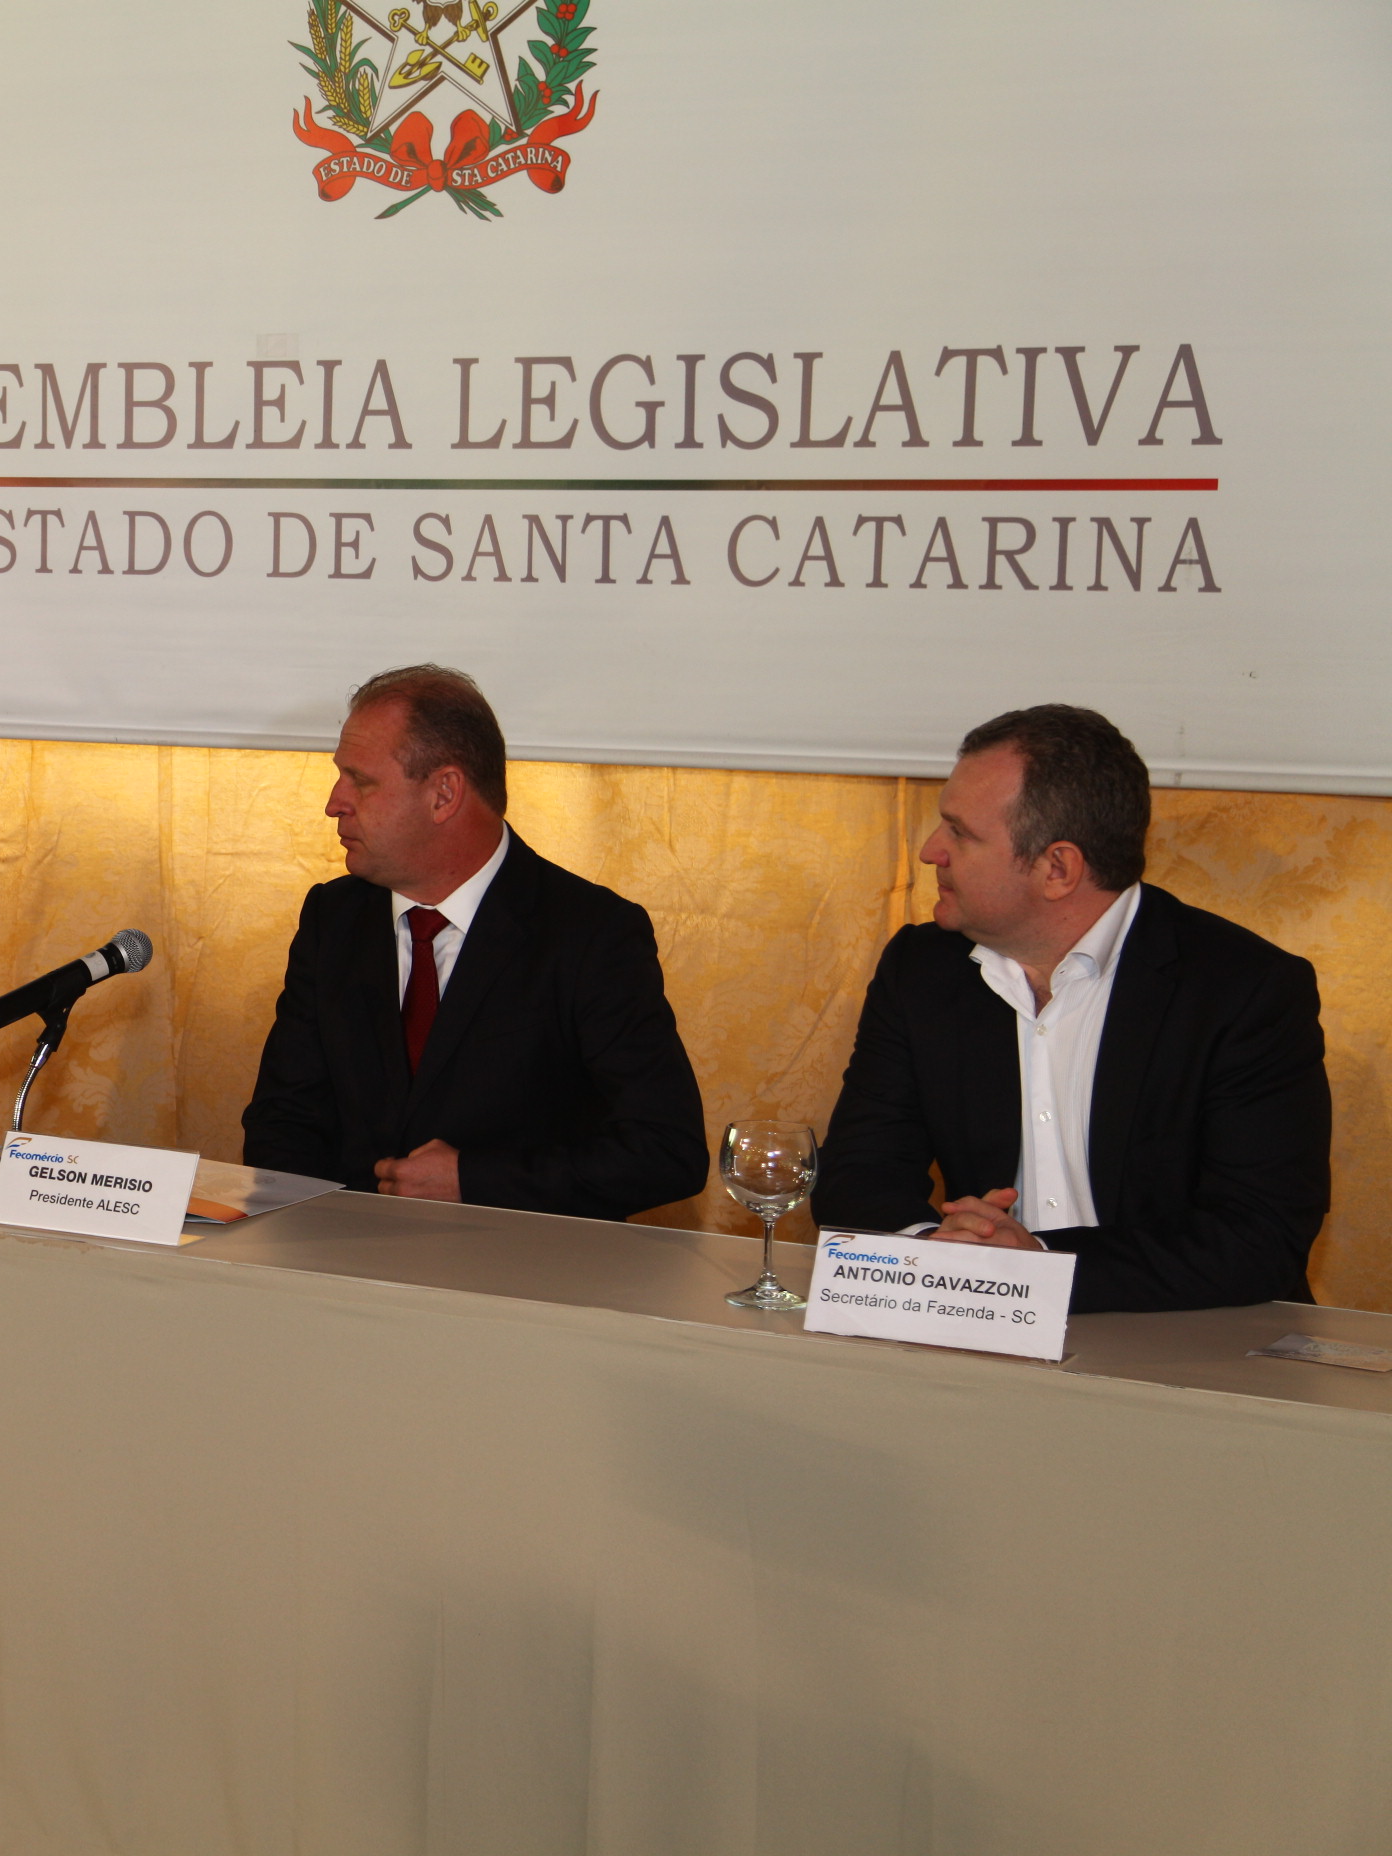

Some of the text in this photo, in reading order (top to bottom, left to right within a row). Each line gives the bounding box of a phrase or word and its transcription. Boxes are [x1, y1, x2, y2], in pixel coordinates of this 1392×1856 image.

[319, 156, 386, 182] ESTADO
[389, 165, 412, 187] DE
[487, 147, 565, 178] CATARINA
[450, 343, 1223, 451] LEGISLATIVA
[266, 511, 377, 580] DE
[411, 512, 692, 586] SANTA
[726, 513, 1222, 593] CATARINA
[9, 1149, 79, 1164] Fecomércio SC
[28, 1165, 154, 1193] GELSON MERISIO
[29, 1189, 141, 1215] Presidente ALESC
[828, 1248, 919, 1267] Fecomércio SC
[833, 1264, 1030, 1299] ANTONIO GAVAZZONI
[820, 1288, 897, 1310] Secretário
[902, 1297, 921, 1312] da
[926, 1300, 995, 1321] Fazenda
[1010, 1309, 1037, 1326] SC
